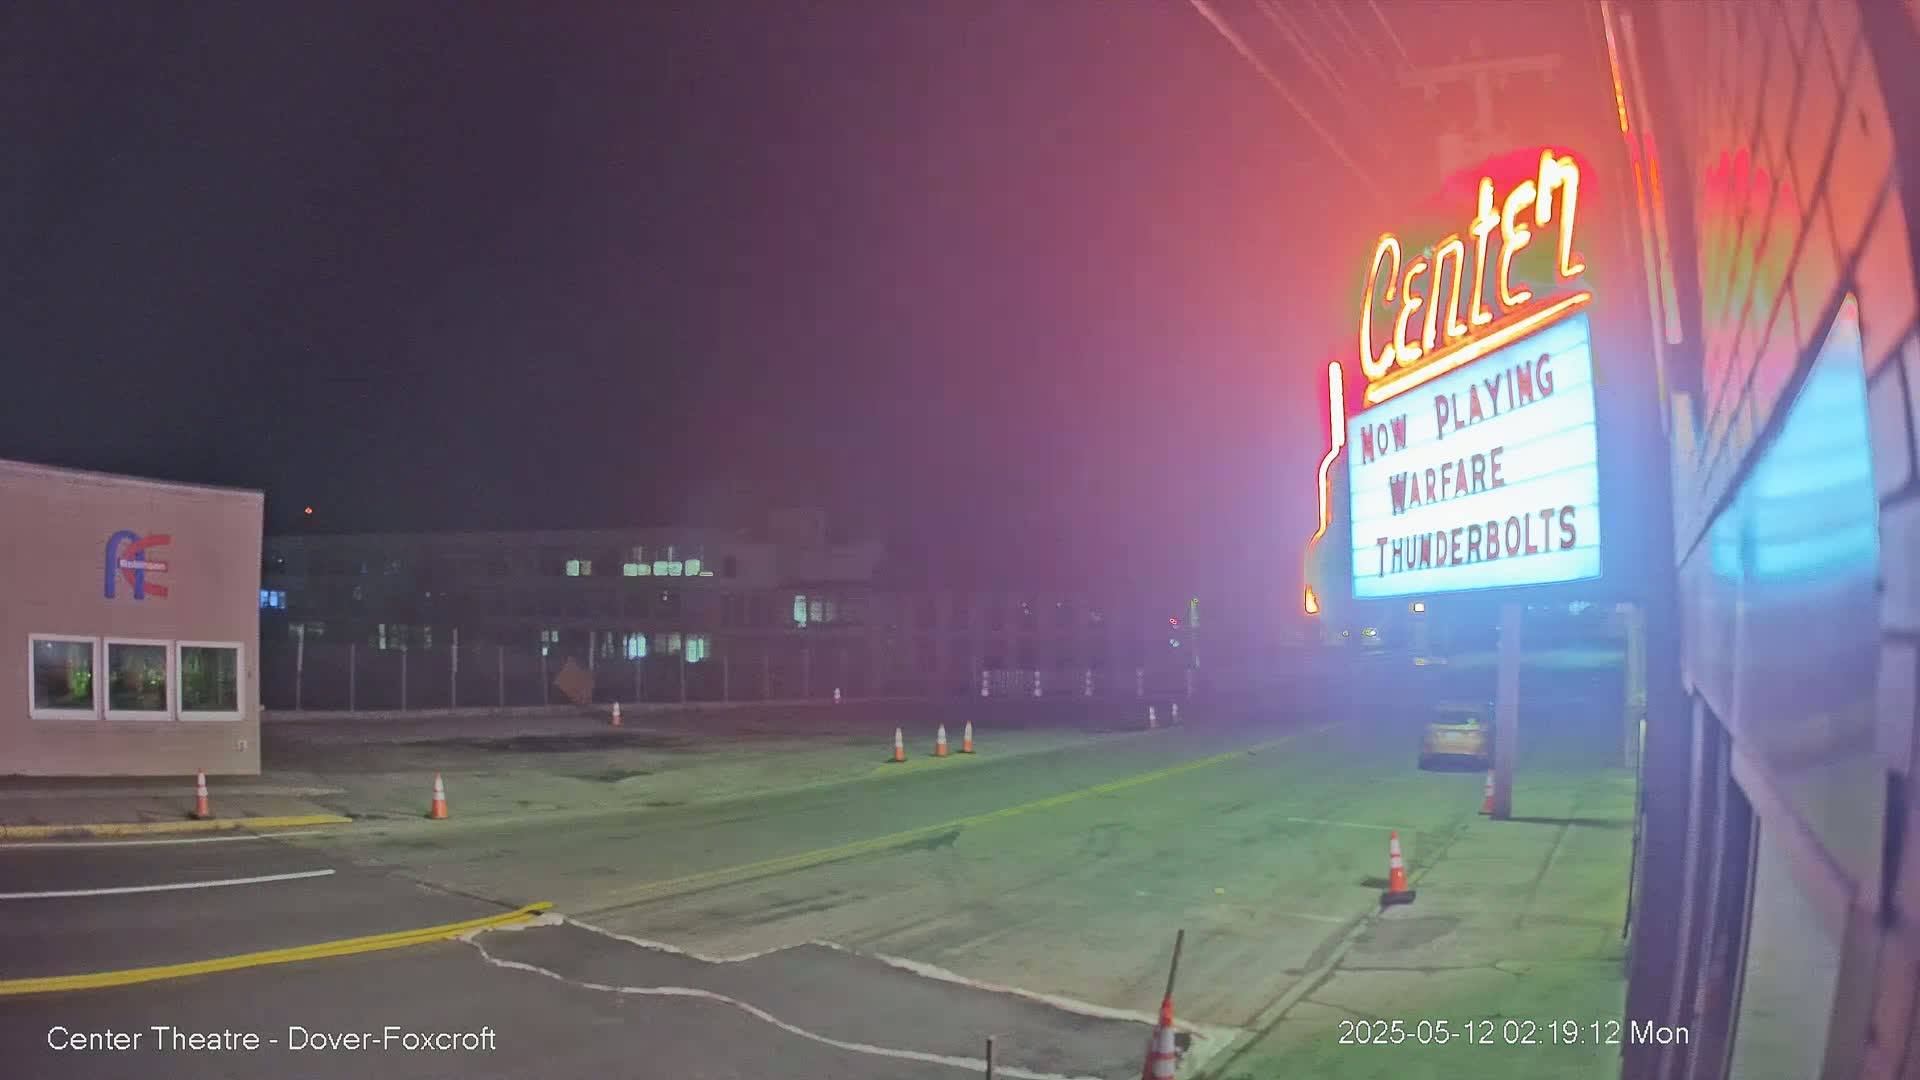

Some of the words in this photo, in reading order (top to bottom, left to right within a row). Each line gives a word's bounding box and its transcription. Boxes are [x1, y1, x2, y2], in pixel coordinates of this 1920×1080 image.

[1360, 149, 1585, 379] Center
[1360, 413, 1407, 465] NOW
[1434, 353, 1554, 440] PLAYING
[1389, 446, 1505, 516] WARFARE
[1377, 505, 1576, 578] THUNDERBOLTS
